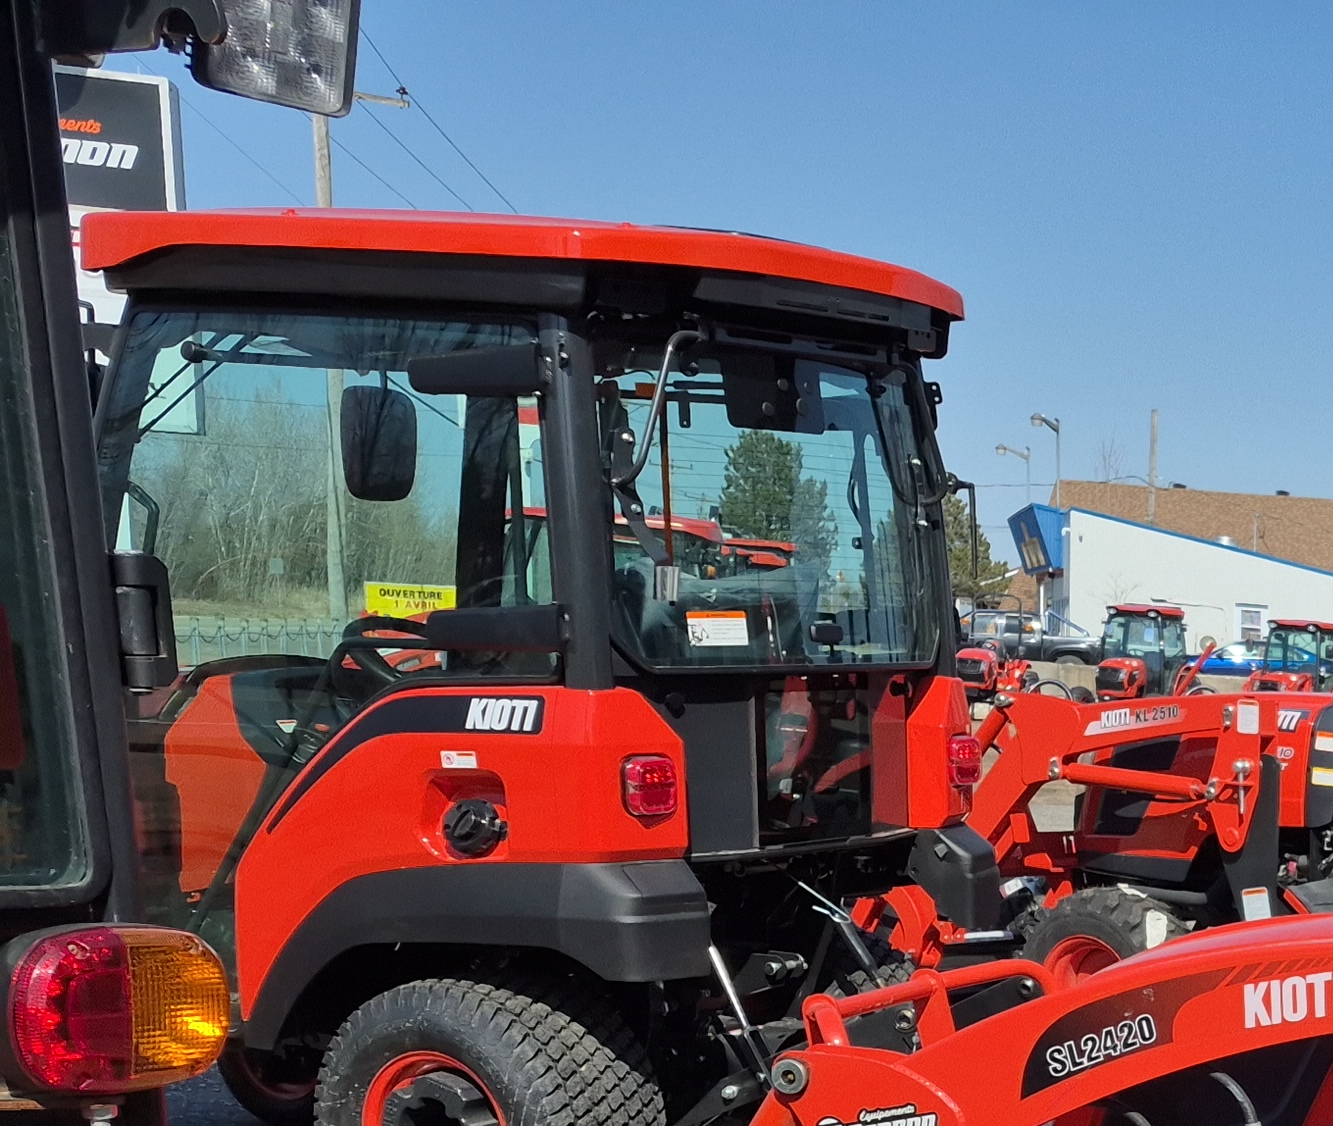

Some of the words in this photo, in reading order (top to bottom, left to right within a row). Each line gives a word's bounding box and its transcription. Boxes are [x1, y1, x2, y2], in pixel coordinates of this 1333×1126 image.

[60, 118, 102, 134] ents
[61, 137, 138, 169] non
[379, 588, 443, 600] OUVERTURE
[394, 600, 399, 608] 1
[405, 601, 438, 609] AVRIL
[464, 697, 539, 732] KIOTI
[1101, 708, 1130, 728] KIOTI
[1135, 709, 1149, 723] KL
[1152, 705, 1178, 720] 2510
[1046, 1014, 1157, 1077] SL2420
